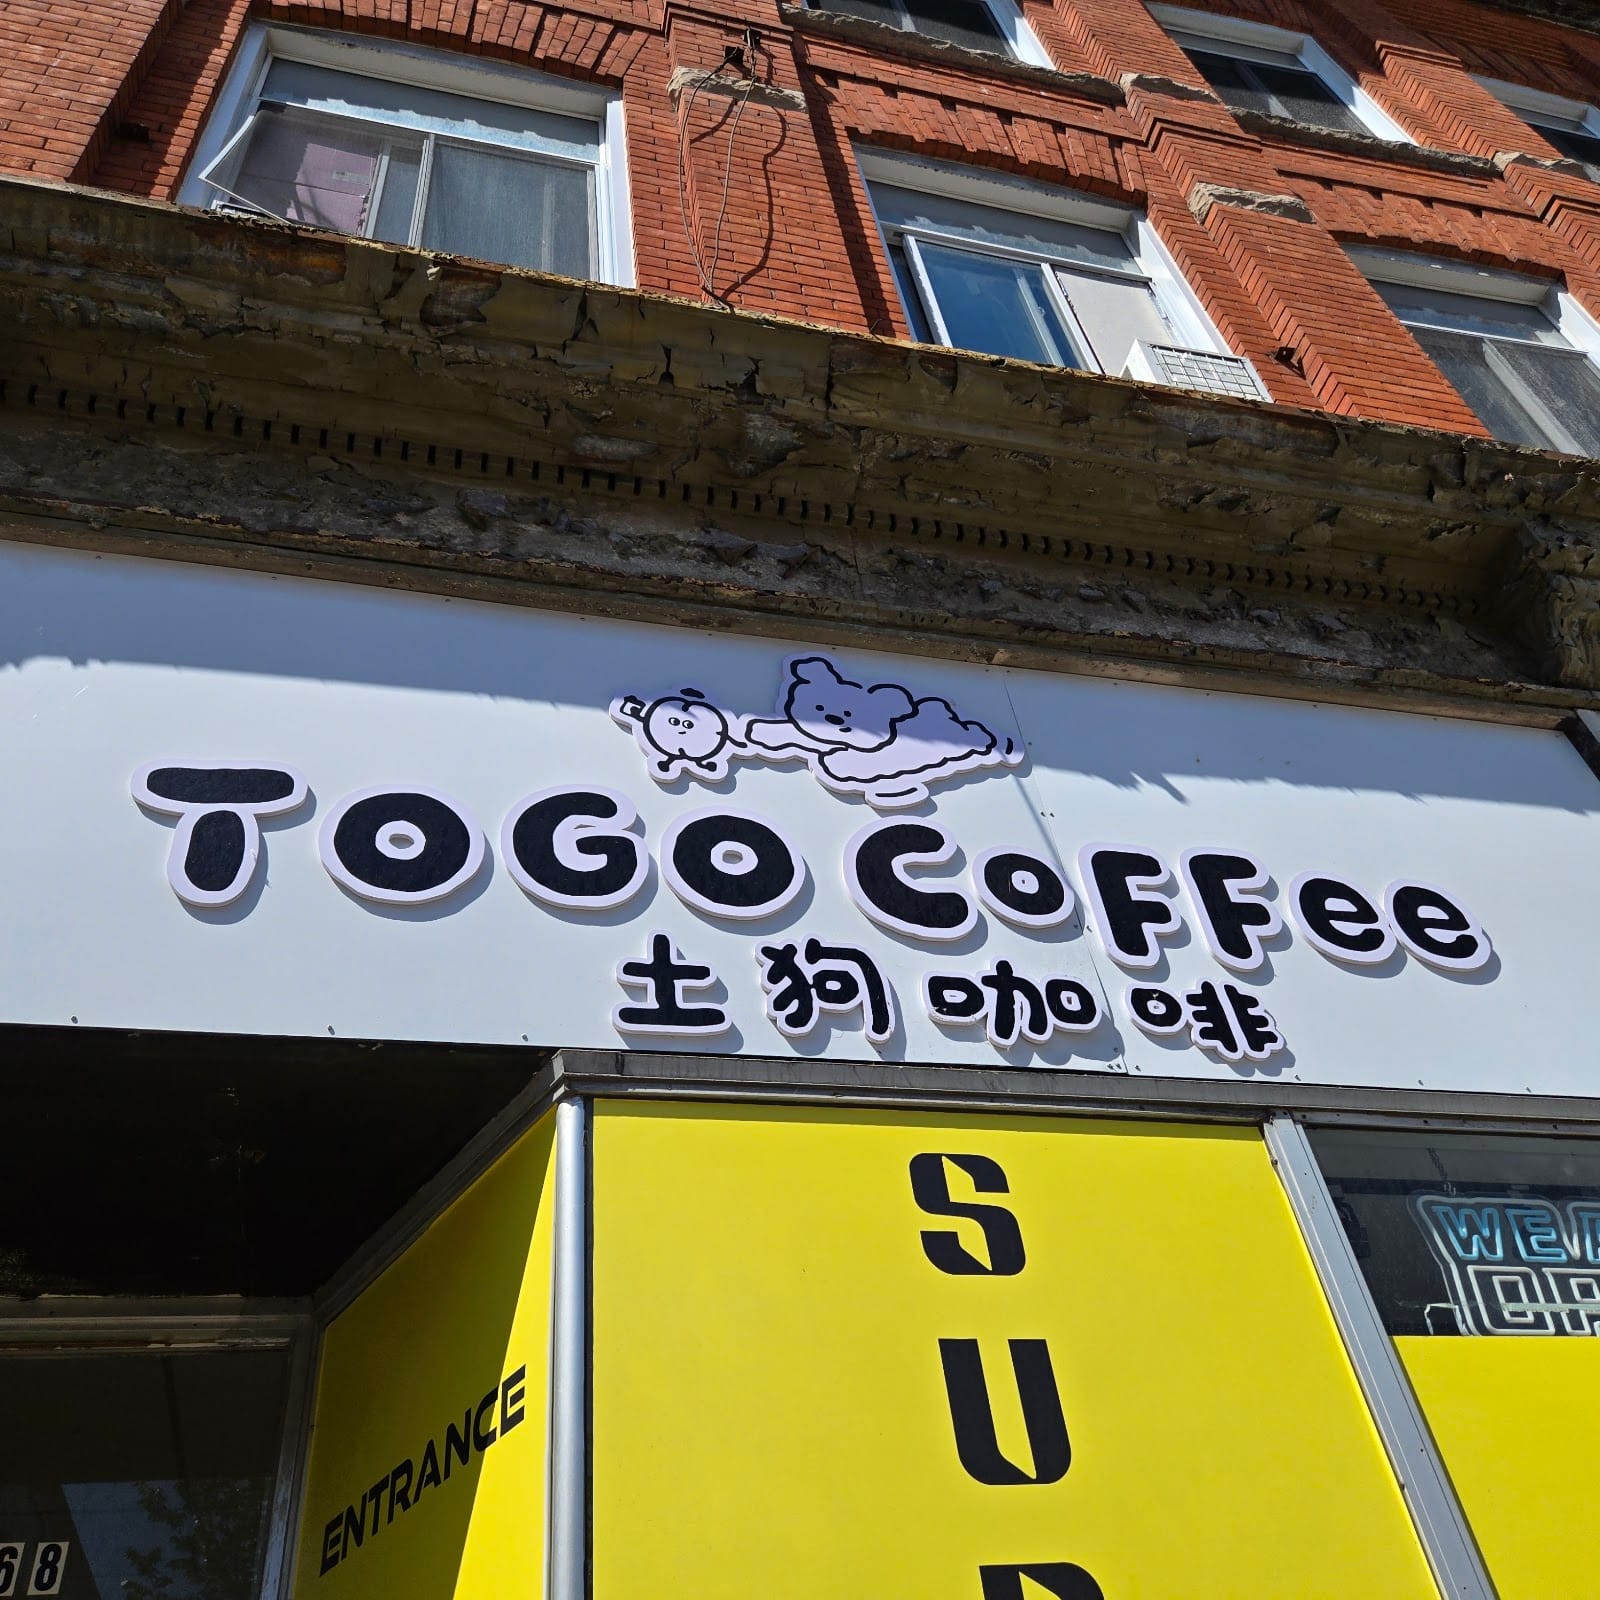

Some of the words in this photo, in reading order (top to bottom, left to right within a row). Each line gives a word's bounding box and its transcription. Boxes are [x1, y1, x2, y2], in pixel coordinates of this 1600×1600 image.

[146, 766, 796, 908] TOGO
[618, 934, 1280, 1054] 土狗咖啡
[319, 1364, 526, 1578] ENTRANCE
[0, 1544, 63, 1593] 68
